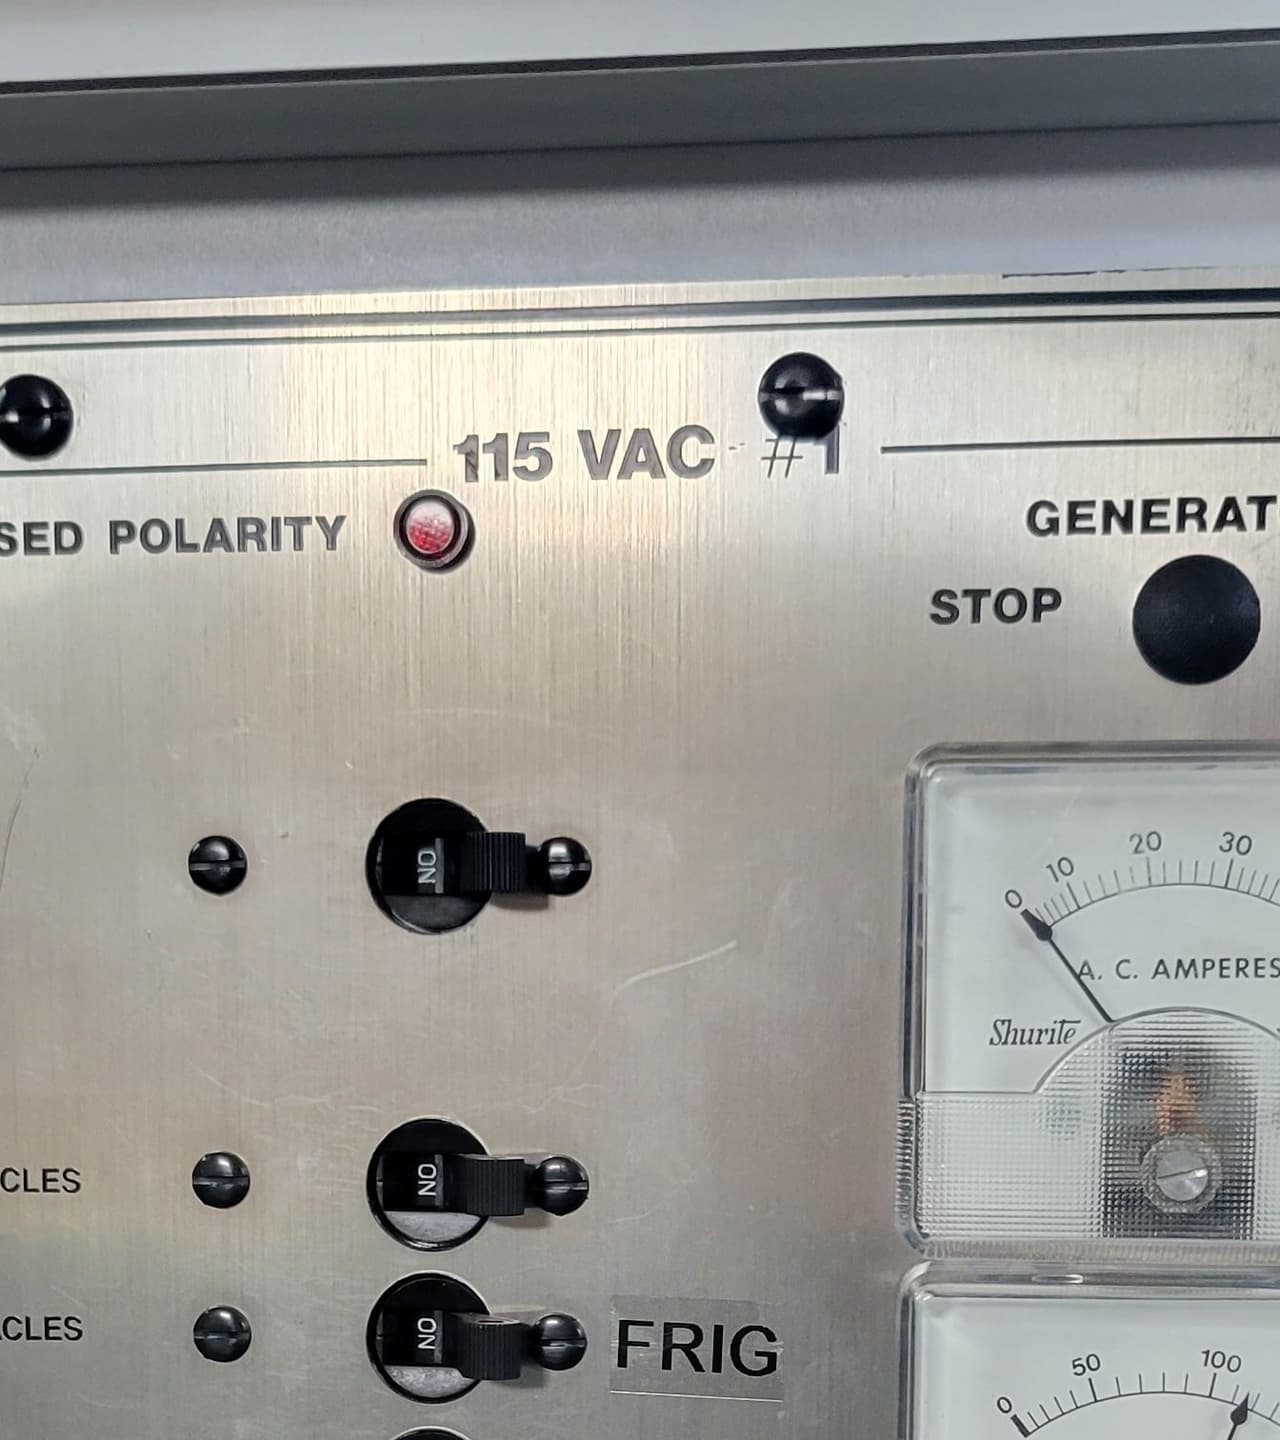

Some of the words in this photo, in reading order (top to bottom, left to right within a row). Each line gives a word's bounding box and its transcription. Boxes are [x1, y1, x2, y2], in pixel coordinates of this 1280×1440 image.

[453, 431, 554, 482] 115
[577, 425, 715, 480] VAC
[110, 516, 346, 553] POLARITY
[929, 588, 1062, 625] STOP
[418, 849, 436, 885] ON
[1004, 889, 1023, 910] 0
[1046, 857, 1075, 884] 10
[1129, 831, 1162, 855] 20
[1219, 831, 1252, 856] 30
[1077, 960, 1103, 980] A.
[1115, 959, 1138, 980] C.
[989, 1018, 1081, 1046] Shurite
[418, 1162, 437, 1197] ON
[417, 1317, 436, 1350] ON
[617, 1319, 779, 1378] FRIG
[996, 1395, 1013, 1415] 0
[1072, 1353, 1102, 1377] 50
[1201, 1349, 1242, 1374] 100
